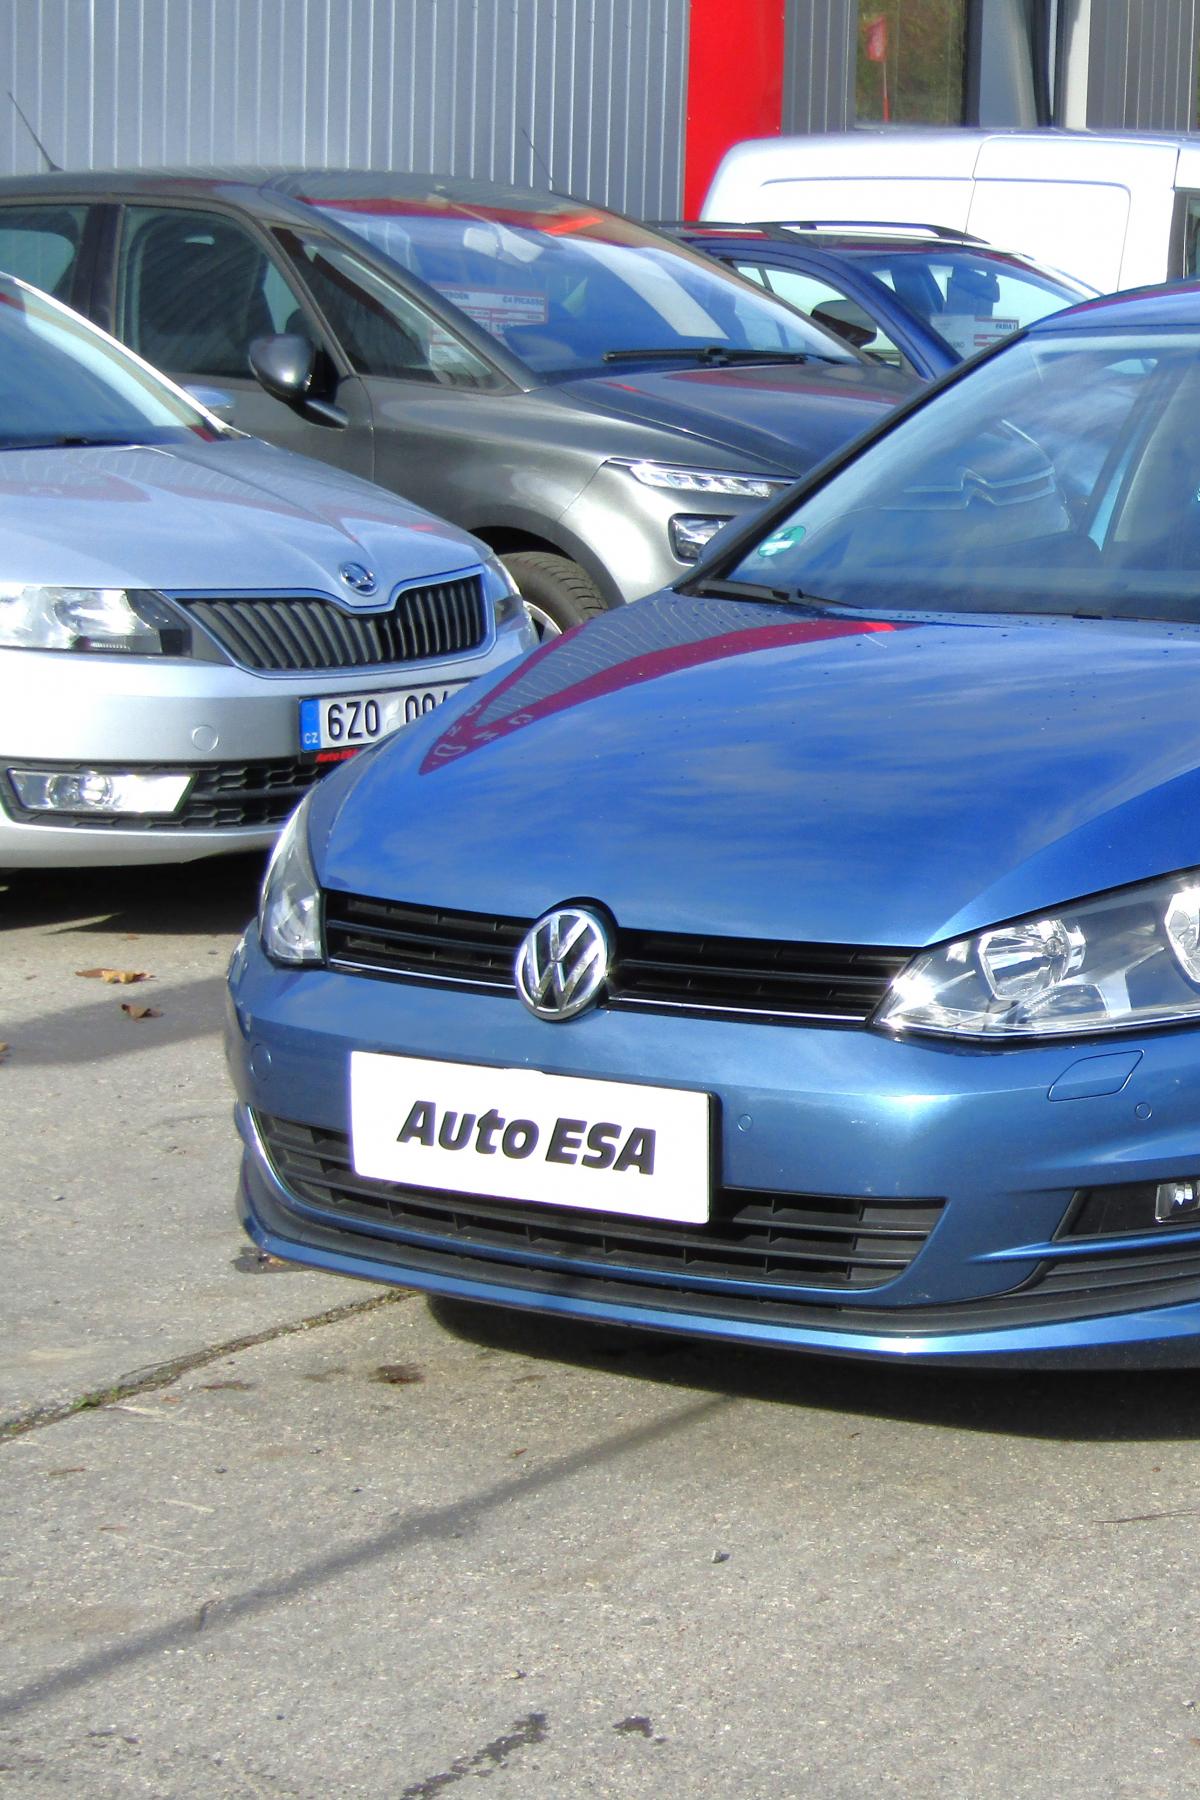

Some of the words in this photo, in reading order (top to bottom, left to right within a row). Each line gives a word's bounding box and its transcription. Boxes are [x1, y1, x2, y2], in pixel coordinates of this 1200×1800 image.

[303, 732, 319, 745] CZ
[396, 1100, 540, 1160] Auto
[545, 1117, 657, 1176] ESA
